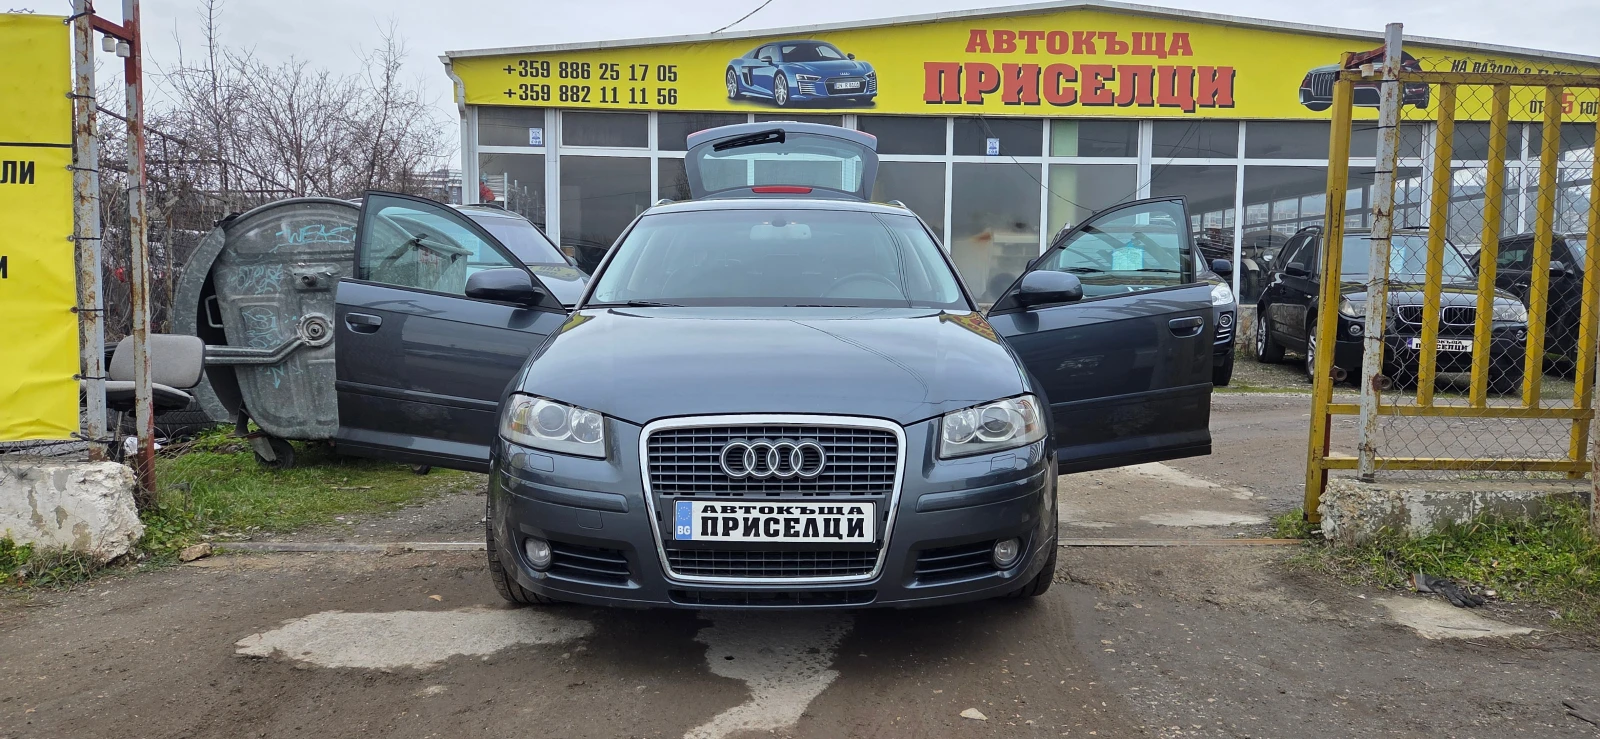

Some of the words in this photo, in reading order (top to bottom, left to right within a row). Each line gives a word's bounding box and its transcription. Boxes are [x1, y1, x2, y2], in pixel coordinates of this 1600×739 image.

[965, 29, 1193, 59] АВТОКЪЩА
[502, 59, 551, 79] +359
[558, 61, 591, 80] 886
[599, 62, 620, 81] 25
[628, 63, 649, 82] 17
[657, 64, 678, 83] 05
[1451, 60, 1467, 73] НА
[502, 83, 551, 102] +359
[559, 84, 591, 103] 882
[599, 86, 620, 104] 11
[628, 87, 649, 105] 11
[657, 87, 678, 105] 56
[923, 62, 1237, 114] ПРИСЕЛЦИ
[1529, 100, 1545, 114] ОТ
[1415, 343, 1468, 351] ПСЕЛЦИ
[700, 505, 865, 516] АВТОКЪЩА
[677, 525, 692, 535] BG
[700, 516, 865, 540] ПРИСЕЛЦИ
